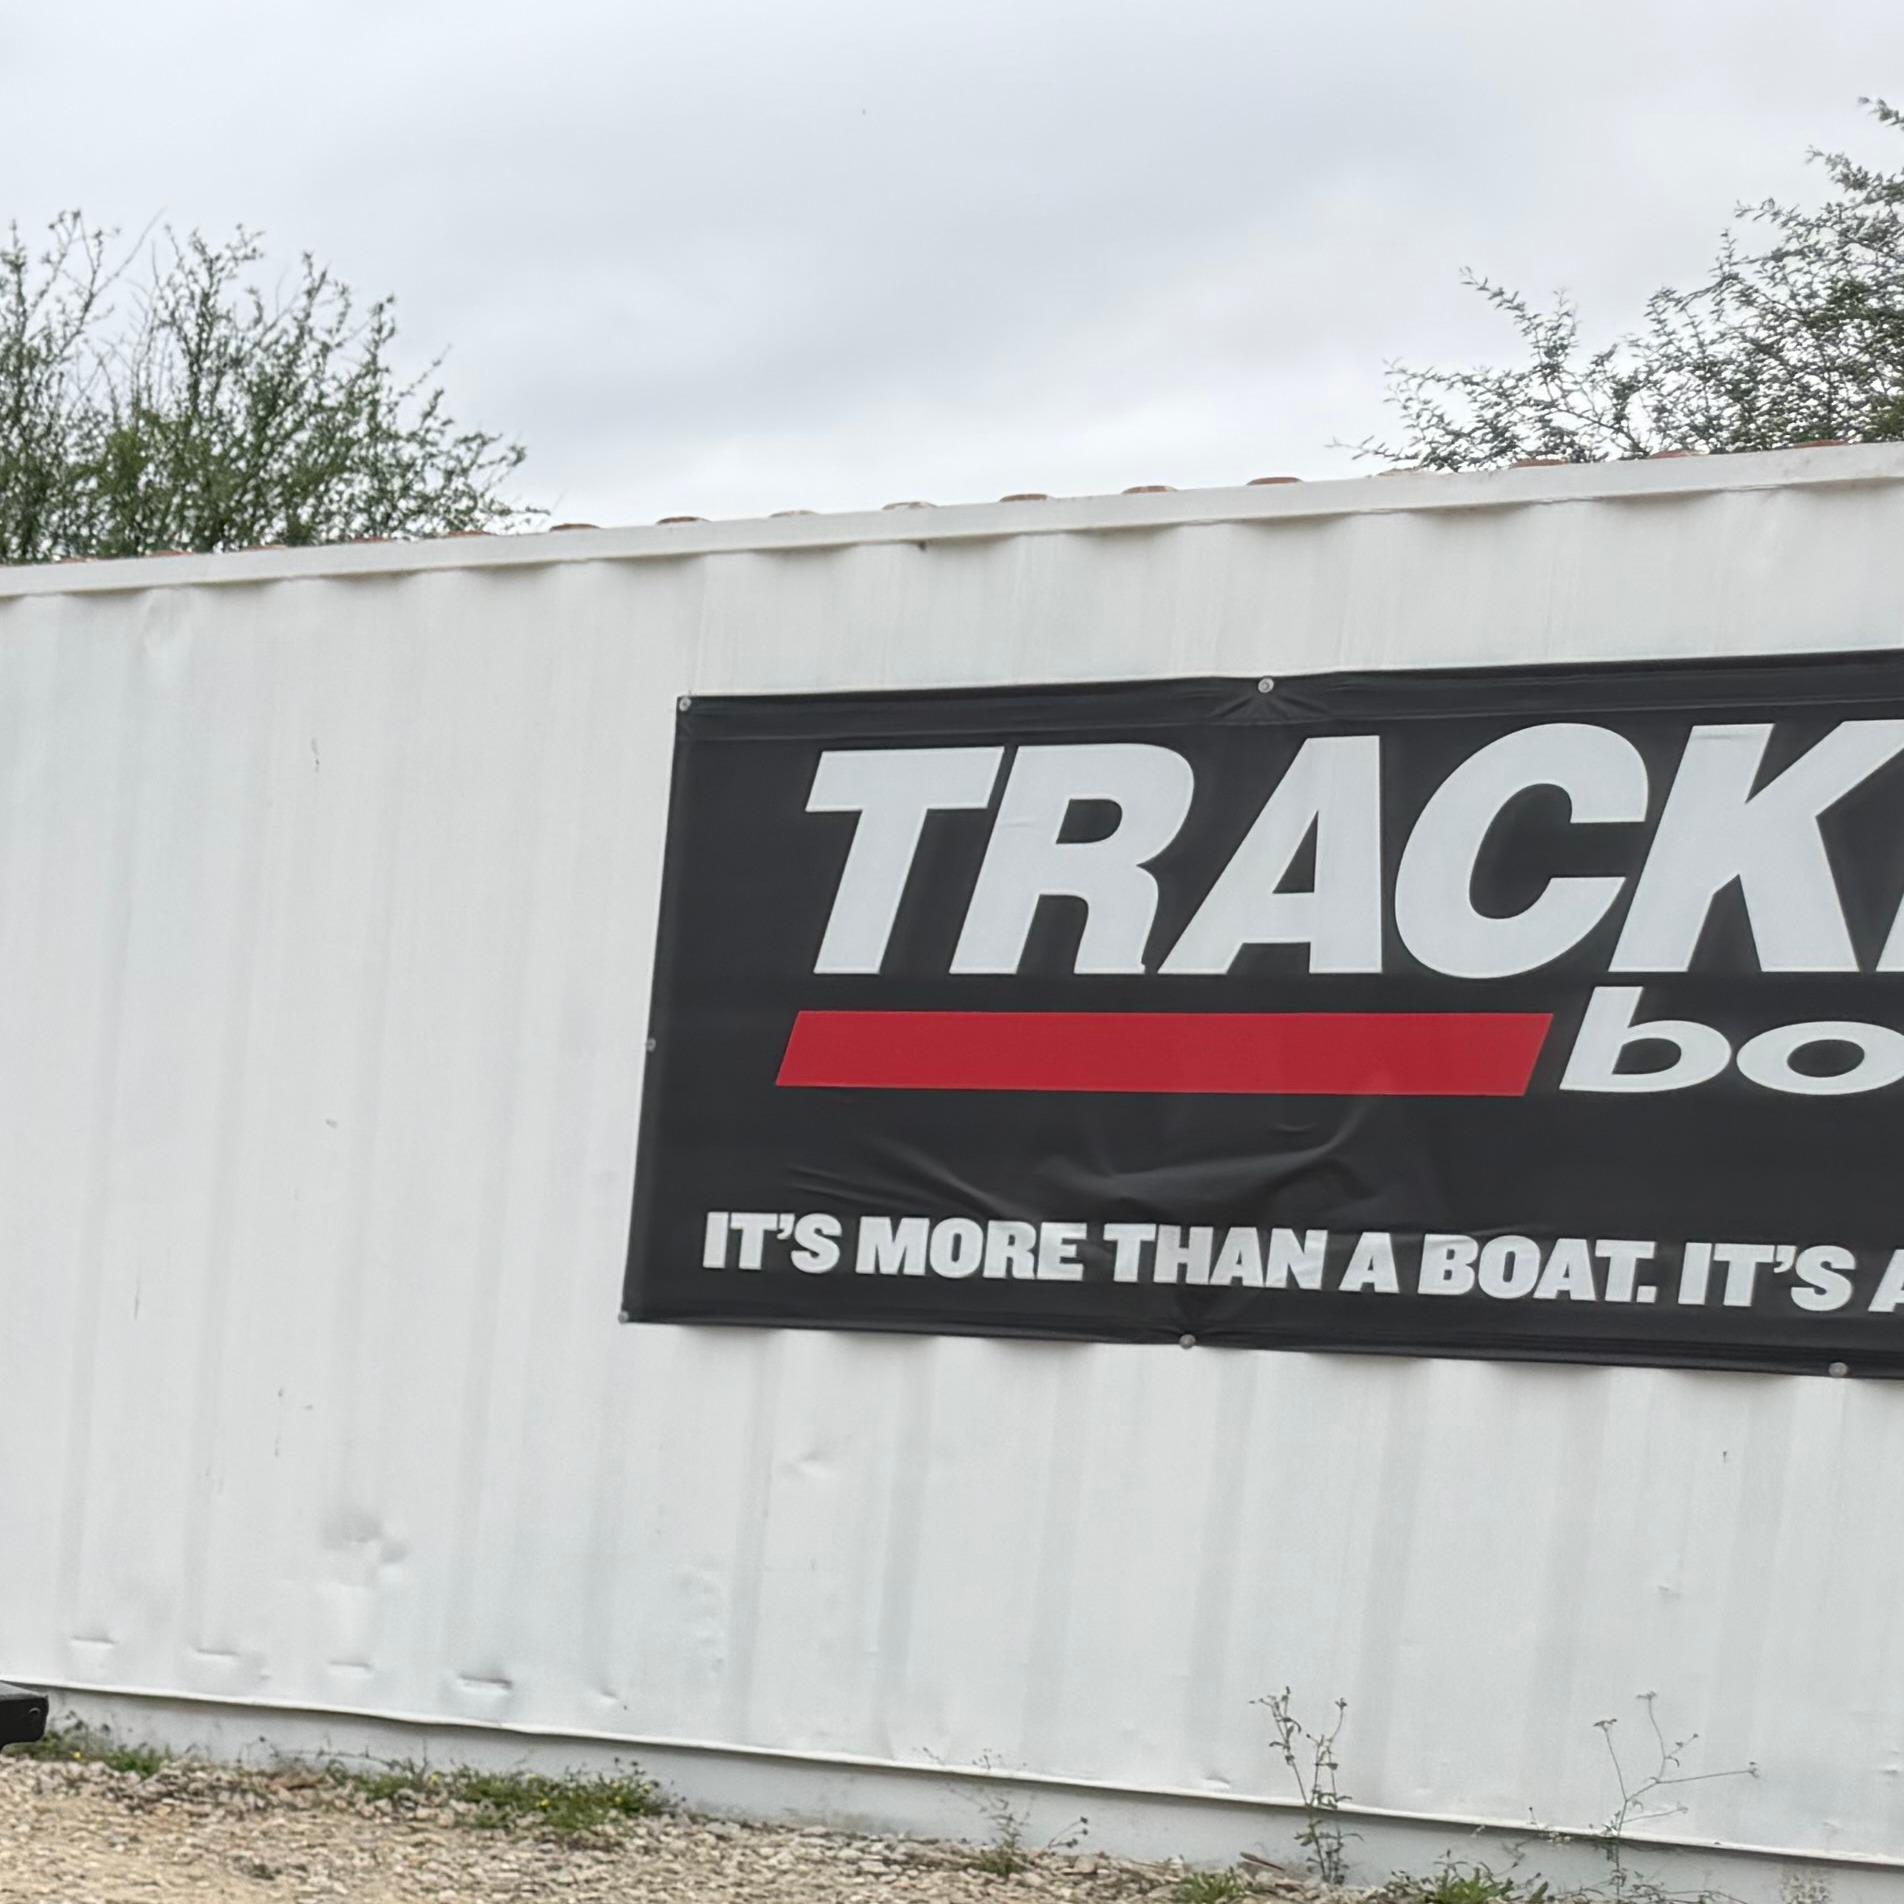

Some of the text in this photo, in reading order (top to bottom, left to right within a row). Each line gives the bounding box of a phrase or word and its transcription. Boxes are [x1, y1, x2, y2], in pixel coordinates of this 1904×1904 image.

[804, 719, 1904, 980] TRACK
[702, 1211, 843, 1274] IT'S
[855, 1216, 1088, 1282] MORE
[1102, 1222, 1329, 1290] THAN
[1338, 1230, 1400, 1294] A
[1417, 1233, 1657, 1304] BOAT.
[1677, 1241, 1856, 1313] IT'S
